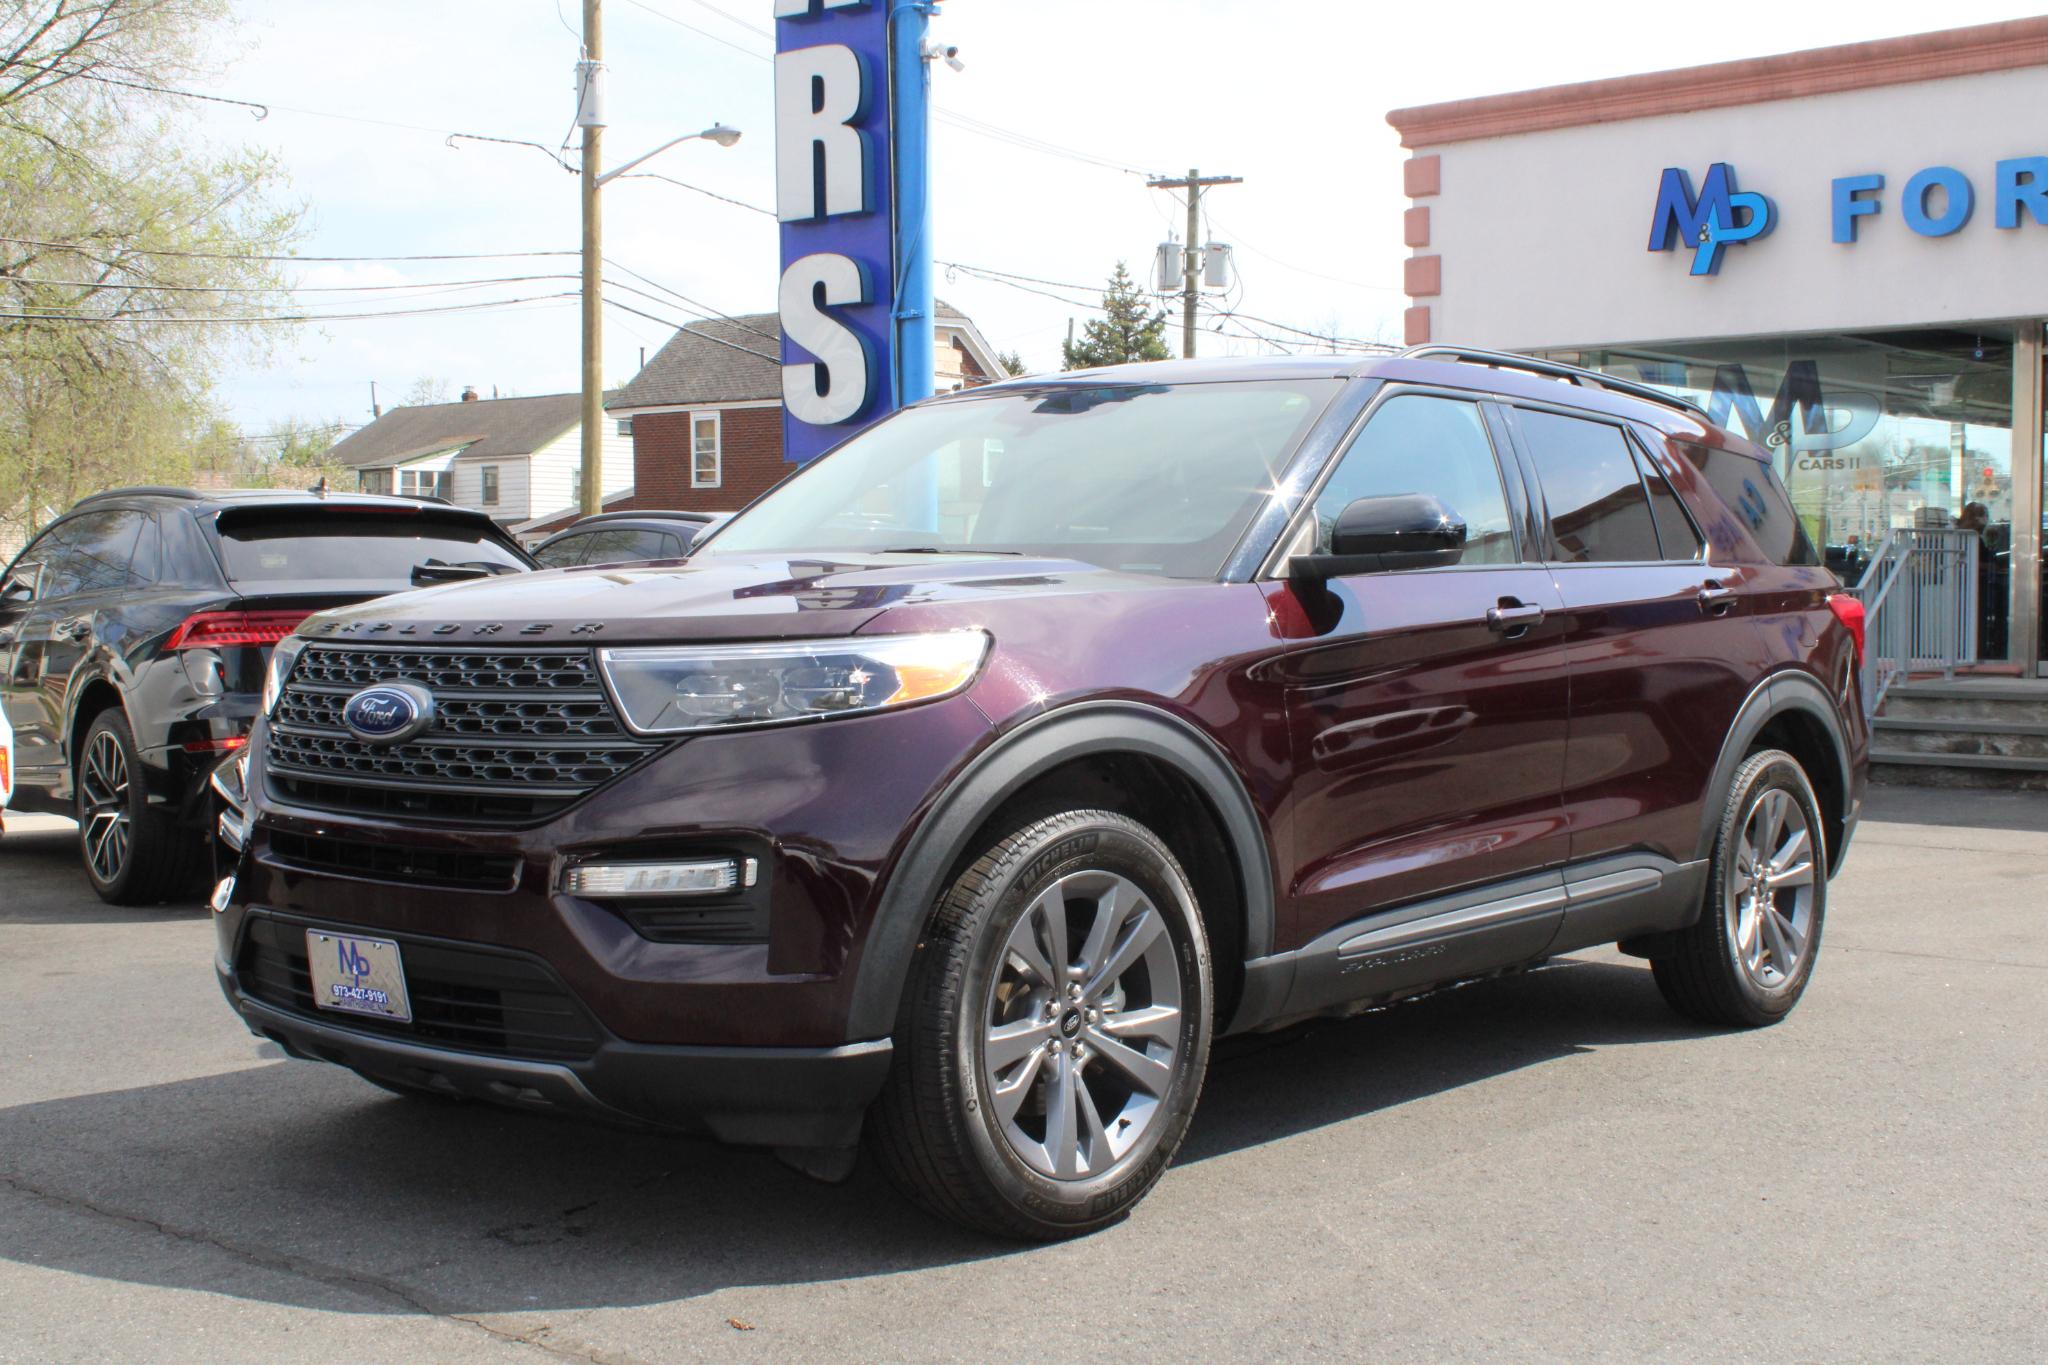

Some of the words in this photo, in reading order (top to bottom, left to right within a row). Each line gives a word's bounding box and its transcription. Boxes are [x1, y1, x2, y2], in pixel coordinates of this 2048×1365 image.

[773, 0, 874, 427] RS
[1831, 155, 2048, 244] FOR
[1798, 457, 1845, 471] CARS
[355, 697, 399, 726] Ford
[332, 984, 388, 1004] 973-427-9191
